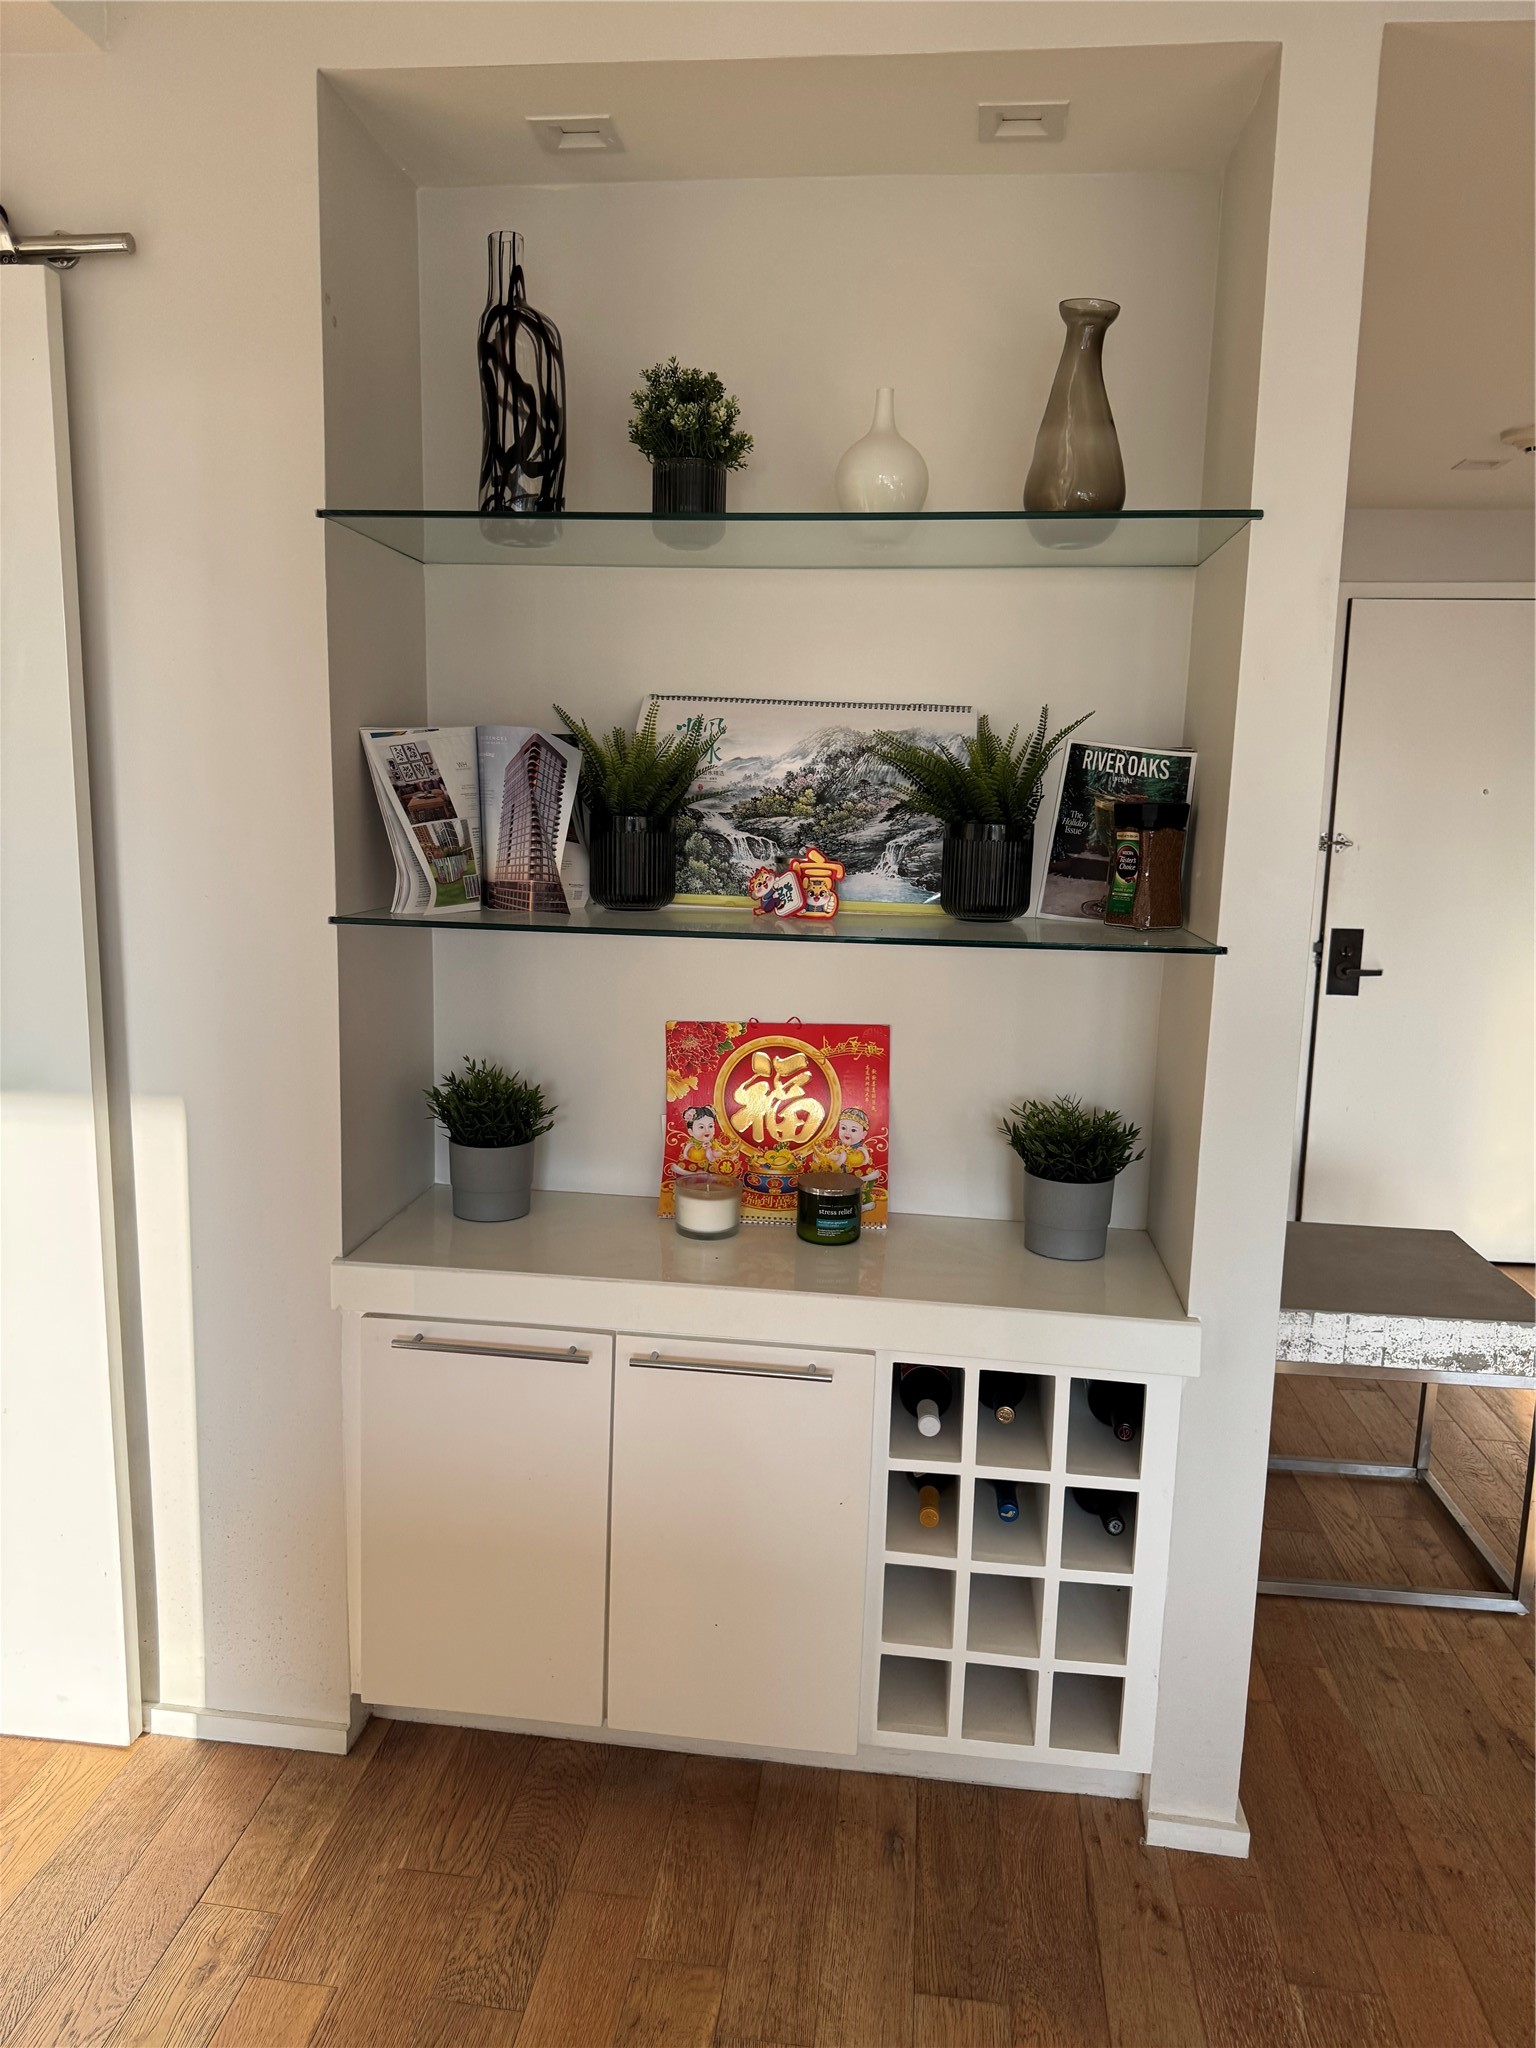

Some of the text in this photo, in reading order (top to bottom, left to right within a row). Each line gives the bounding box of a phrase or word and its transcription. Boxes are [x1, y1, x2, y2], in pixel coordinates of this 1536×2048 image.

[1082, 750, 1170, 780] RIVER OAKS
[1070, 810, 1084, 819] The
[1061, 817, 1089, 830] Holiday
[1064, 825, 1083, 835] Issue
[1119, 855, 1137, 864] Taster's
[1119, 863, 1136, 871] Choice
[730, 1051, 825, 1143] 福
[838, 1207, 853, 1215] relief
